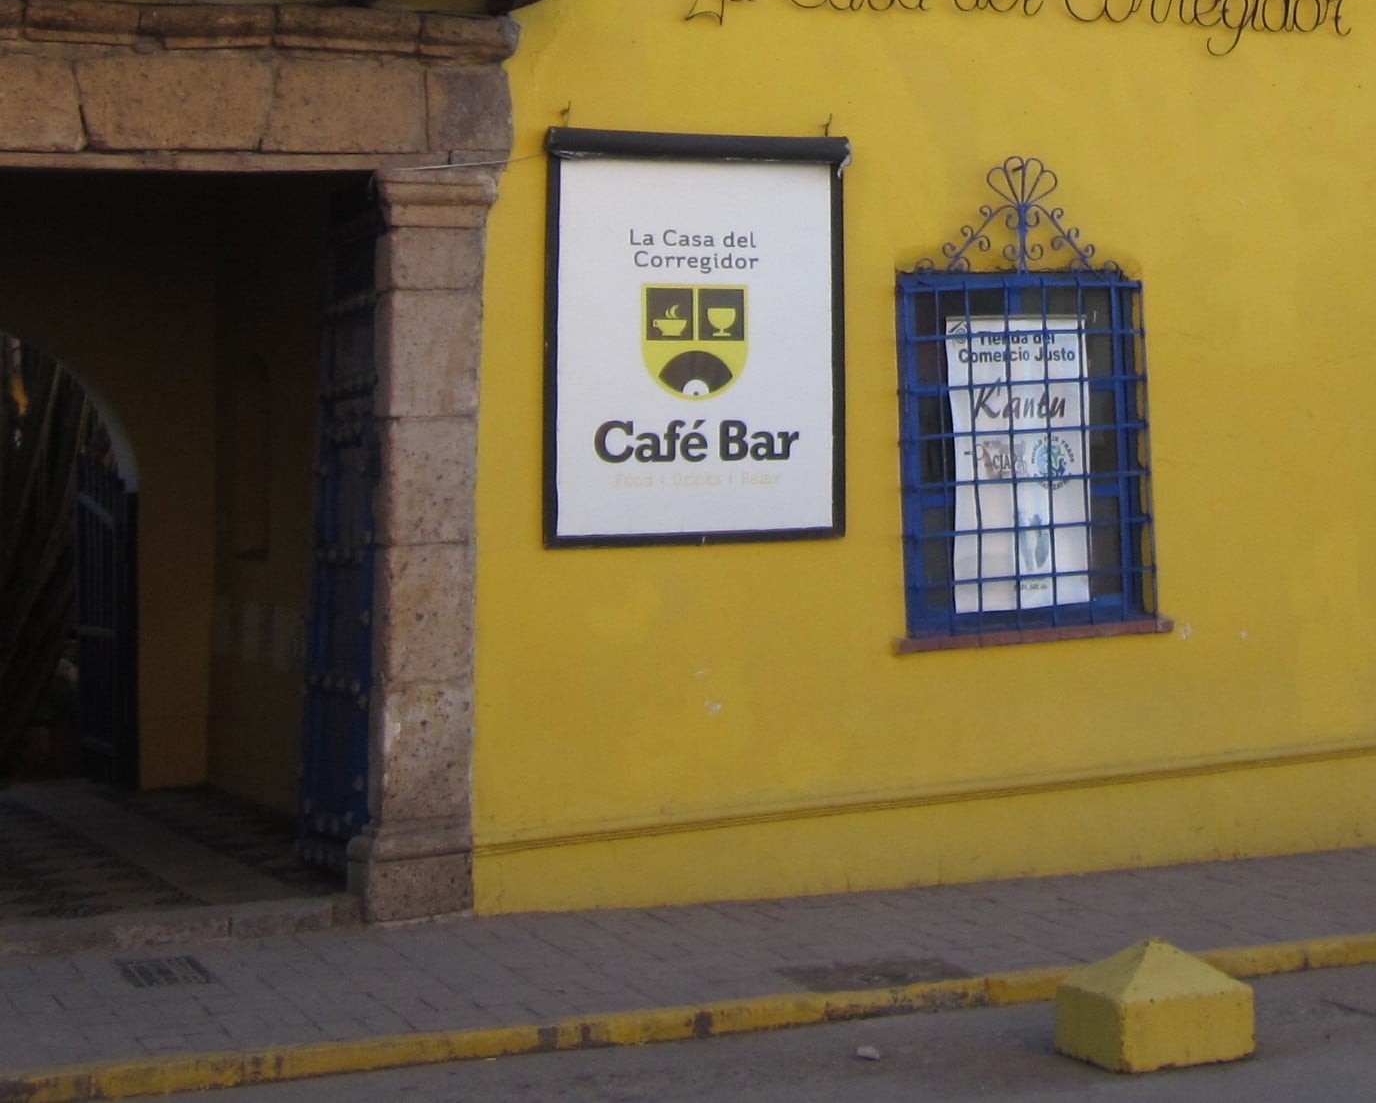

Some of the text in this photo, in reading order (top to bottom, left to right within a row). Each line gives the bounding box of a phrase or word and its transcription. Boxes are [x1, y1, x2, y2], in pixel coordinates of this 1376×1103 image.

[629, 228, 757, 249] La Casa del
[633, 251, 759, 274] Corregidor
[1034, 347, 1076, 362] Justo
[594, 419, 800, 464] Café Bar
